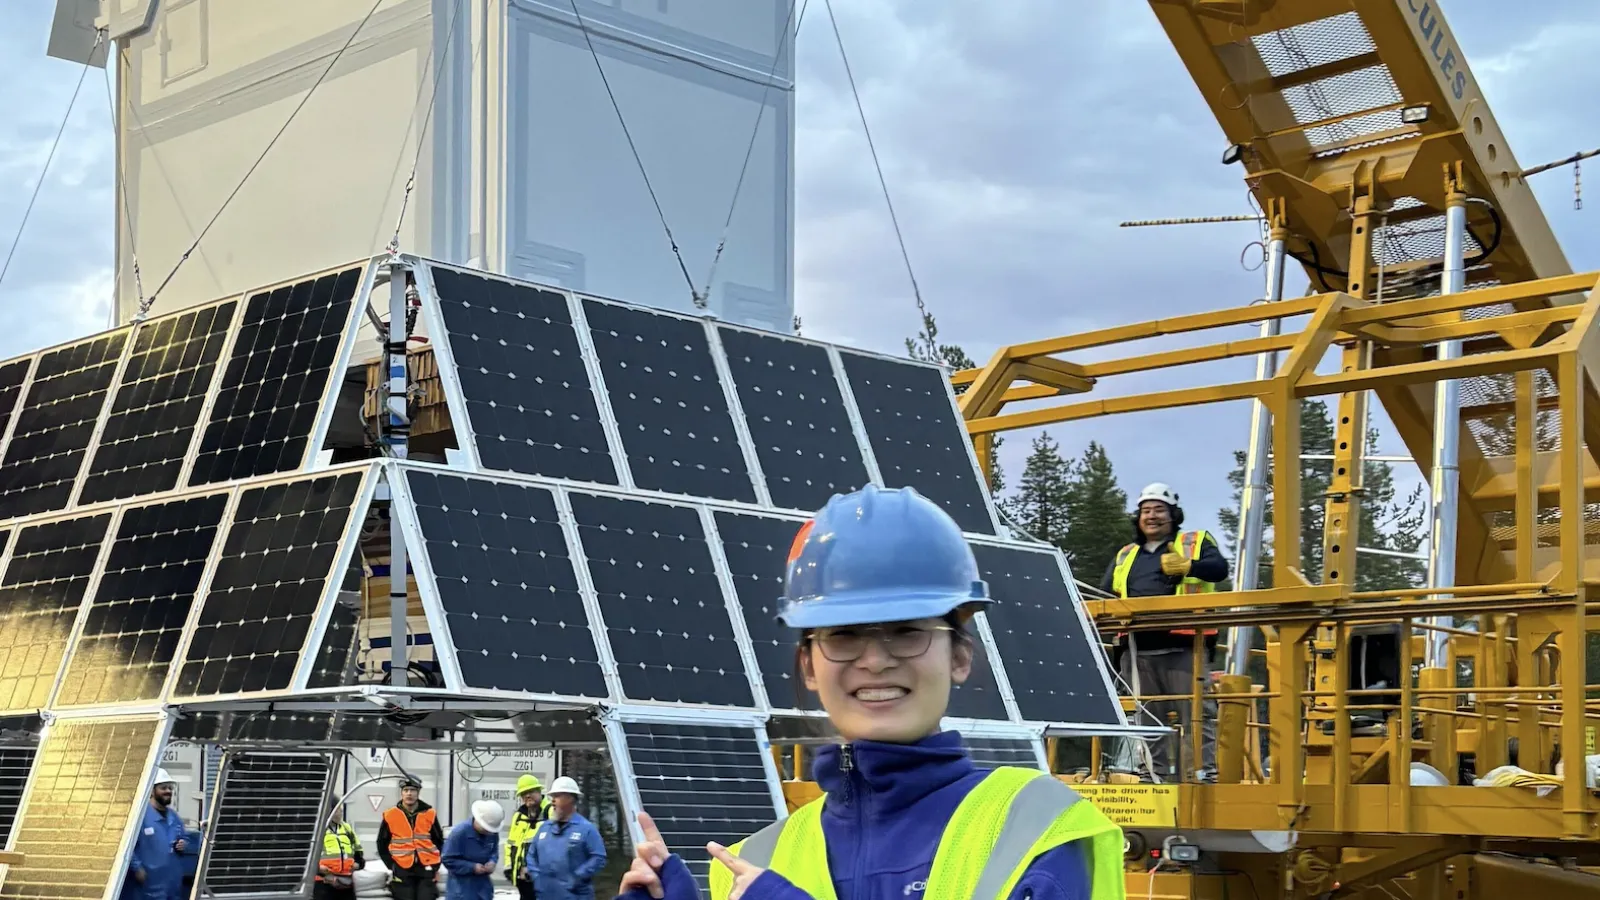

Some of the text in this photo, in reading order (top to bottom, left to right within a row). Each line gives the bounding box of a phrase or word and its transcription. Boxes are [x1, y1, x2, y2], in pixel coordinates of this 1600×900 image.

[163, 751, 178, 761] 2G1
[514, 761, 533, 771] 22G1
[1097, 796, 1137, 804] visibility.
